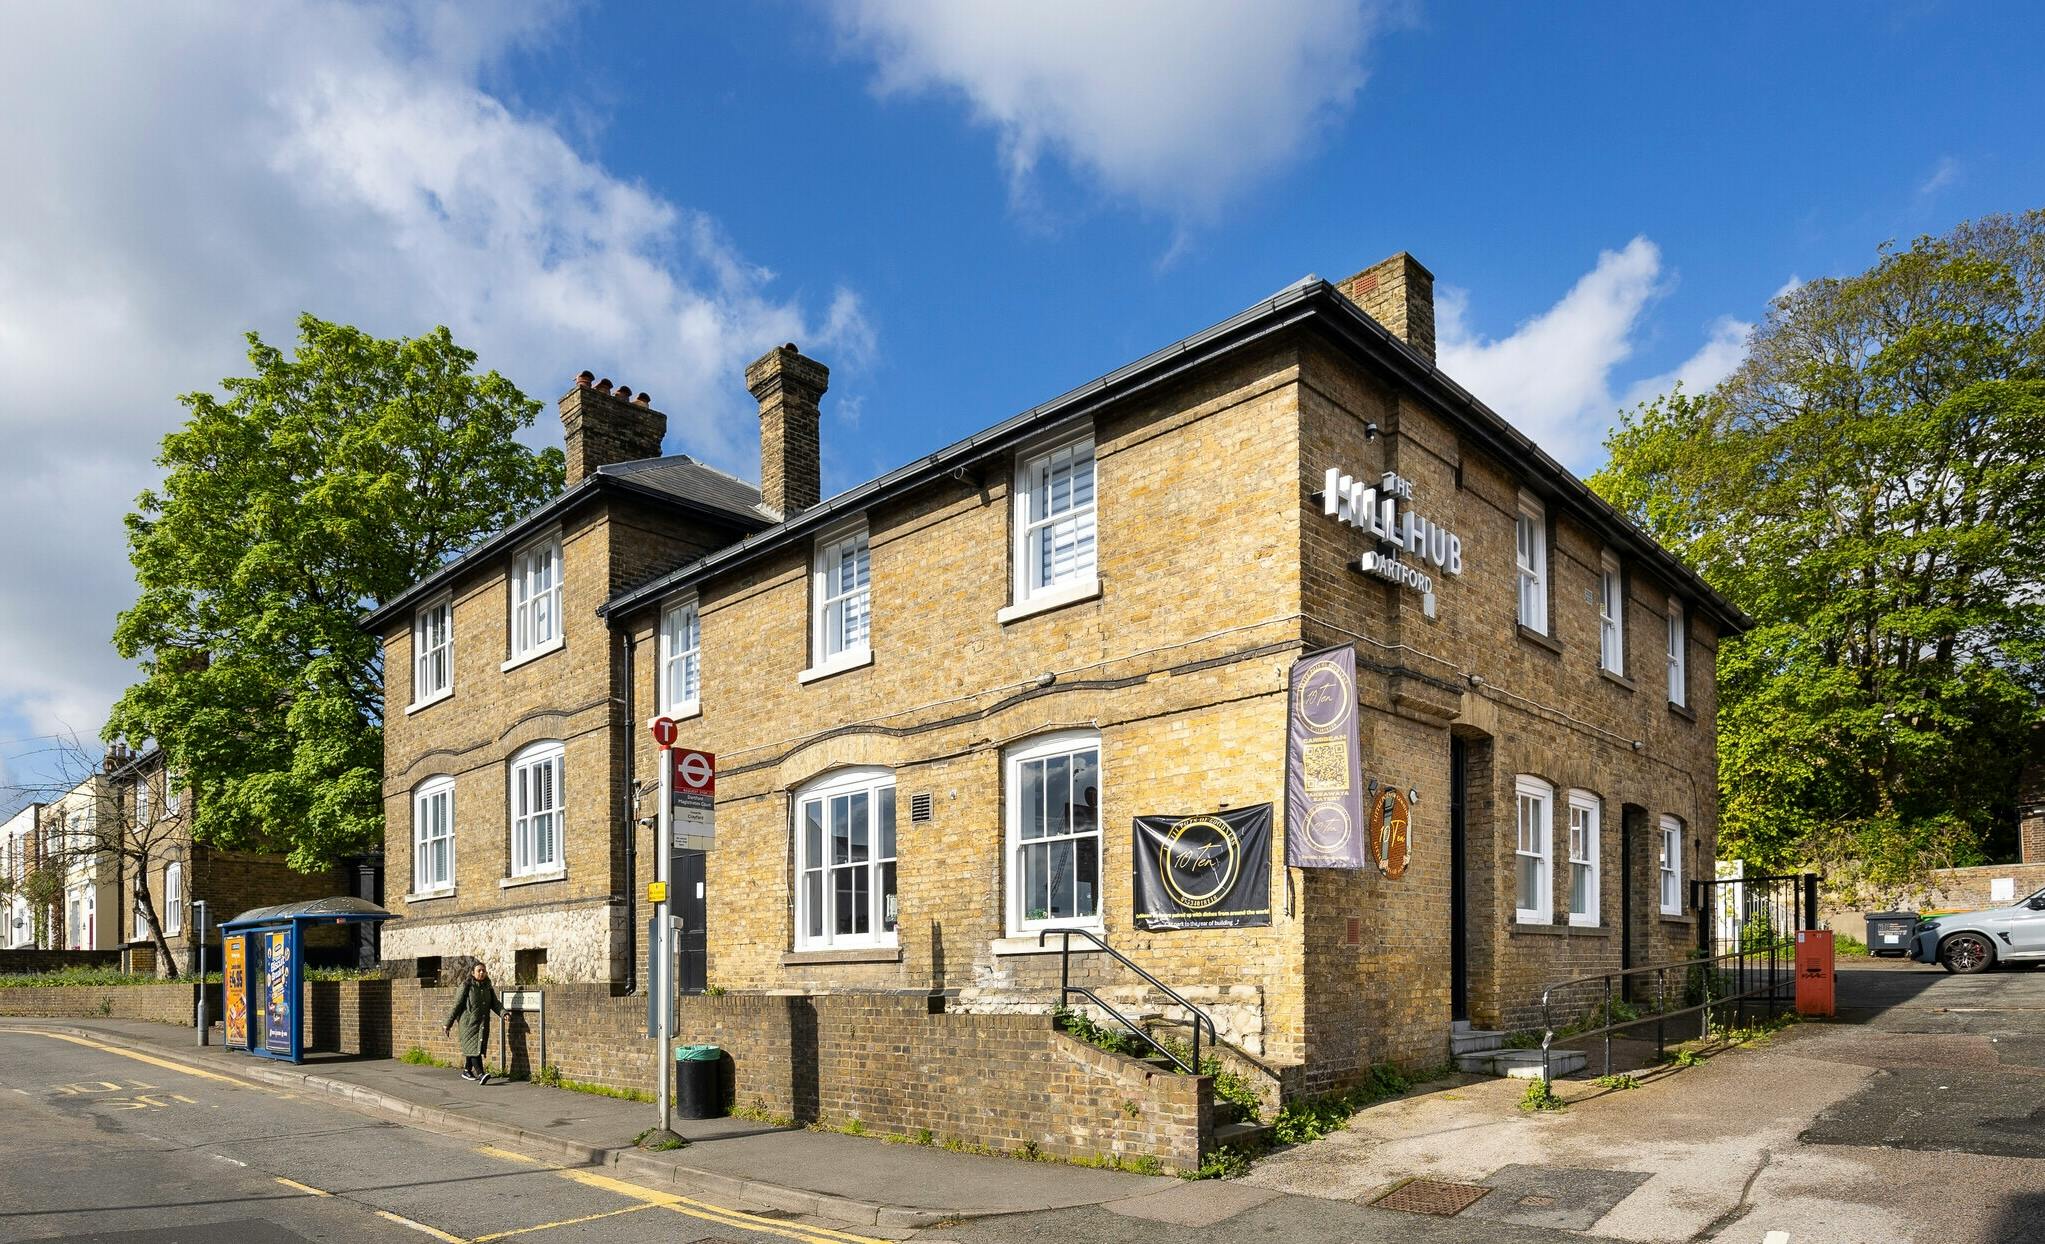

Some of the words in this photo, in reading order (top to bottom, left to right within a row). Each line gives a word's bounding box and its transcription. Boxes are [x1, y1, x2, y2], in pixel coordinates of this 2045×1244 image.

[1381, 471, 1413, 501] THE
[1325, 467, 1404, 548] HILL
[1402, 511, 1462, 576] HUB
[1361, 551, 1433, 595] DARTFORD
[660, 721, 673, 742] T
[1379, 825, 1391, 843] 10
[1192, 842, 1222, 872] Ten
[1214, 919, 1233, 927] building
